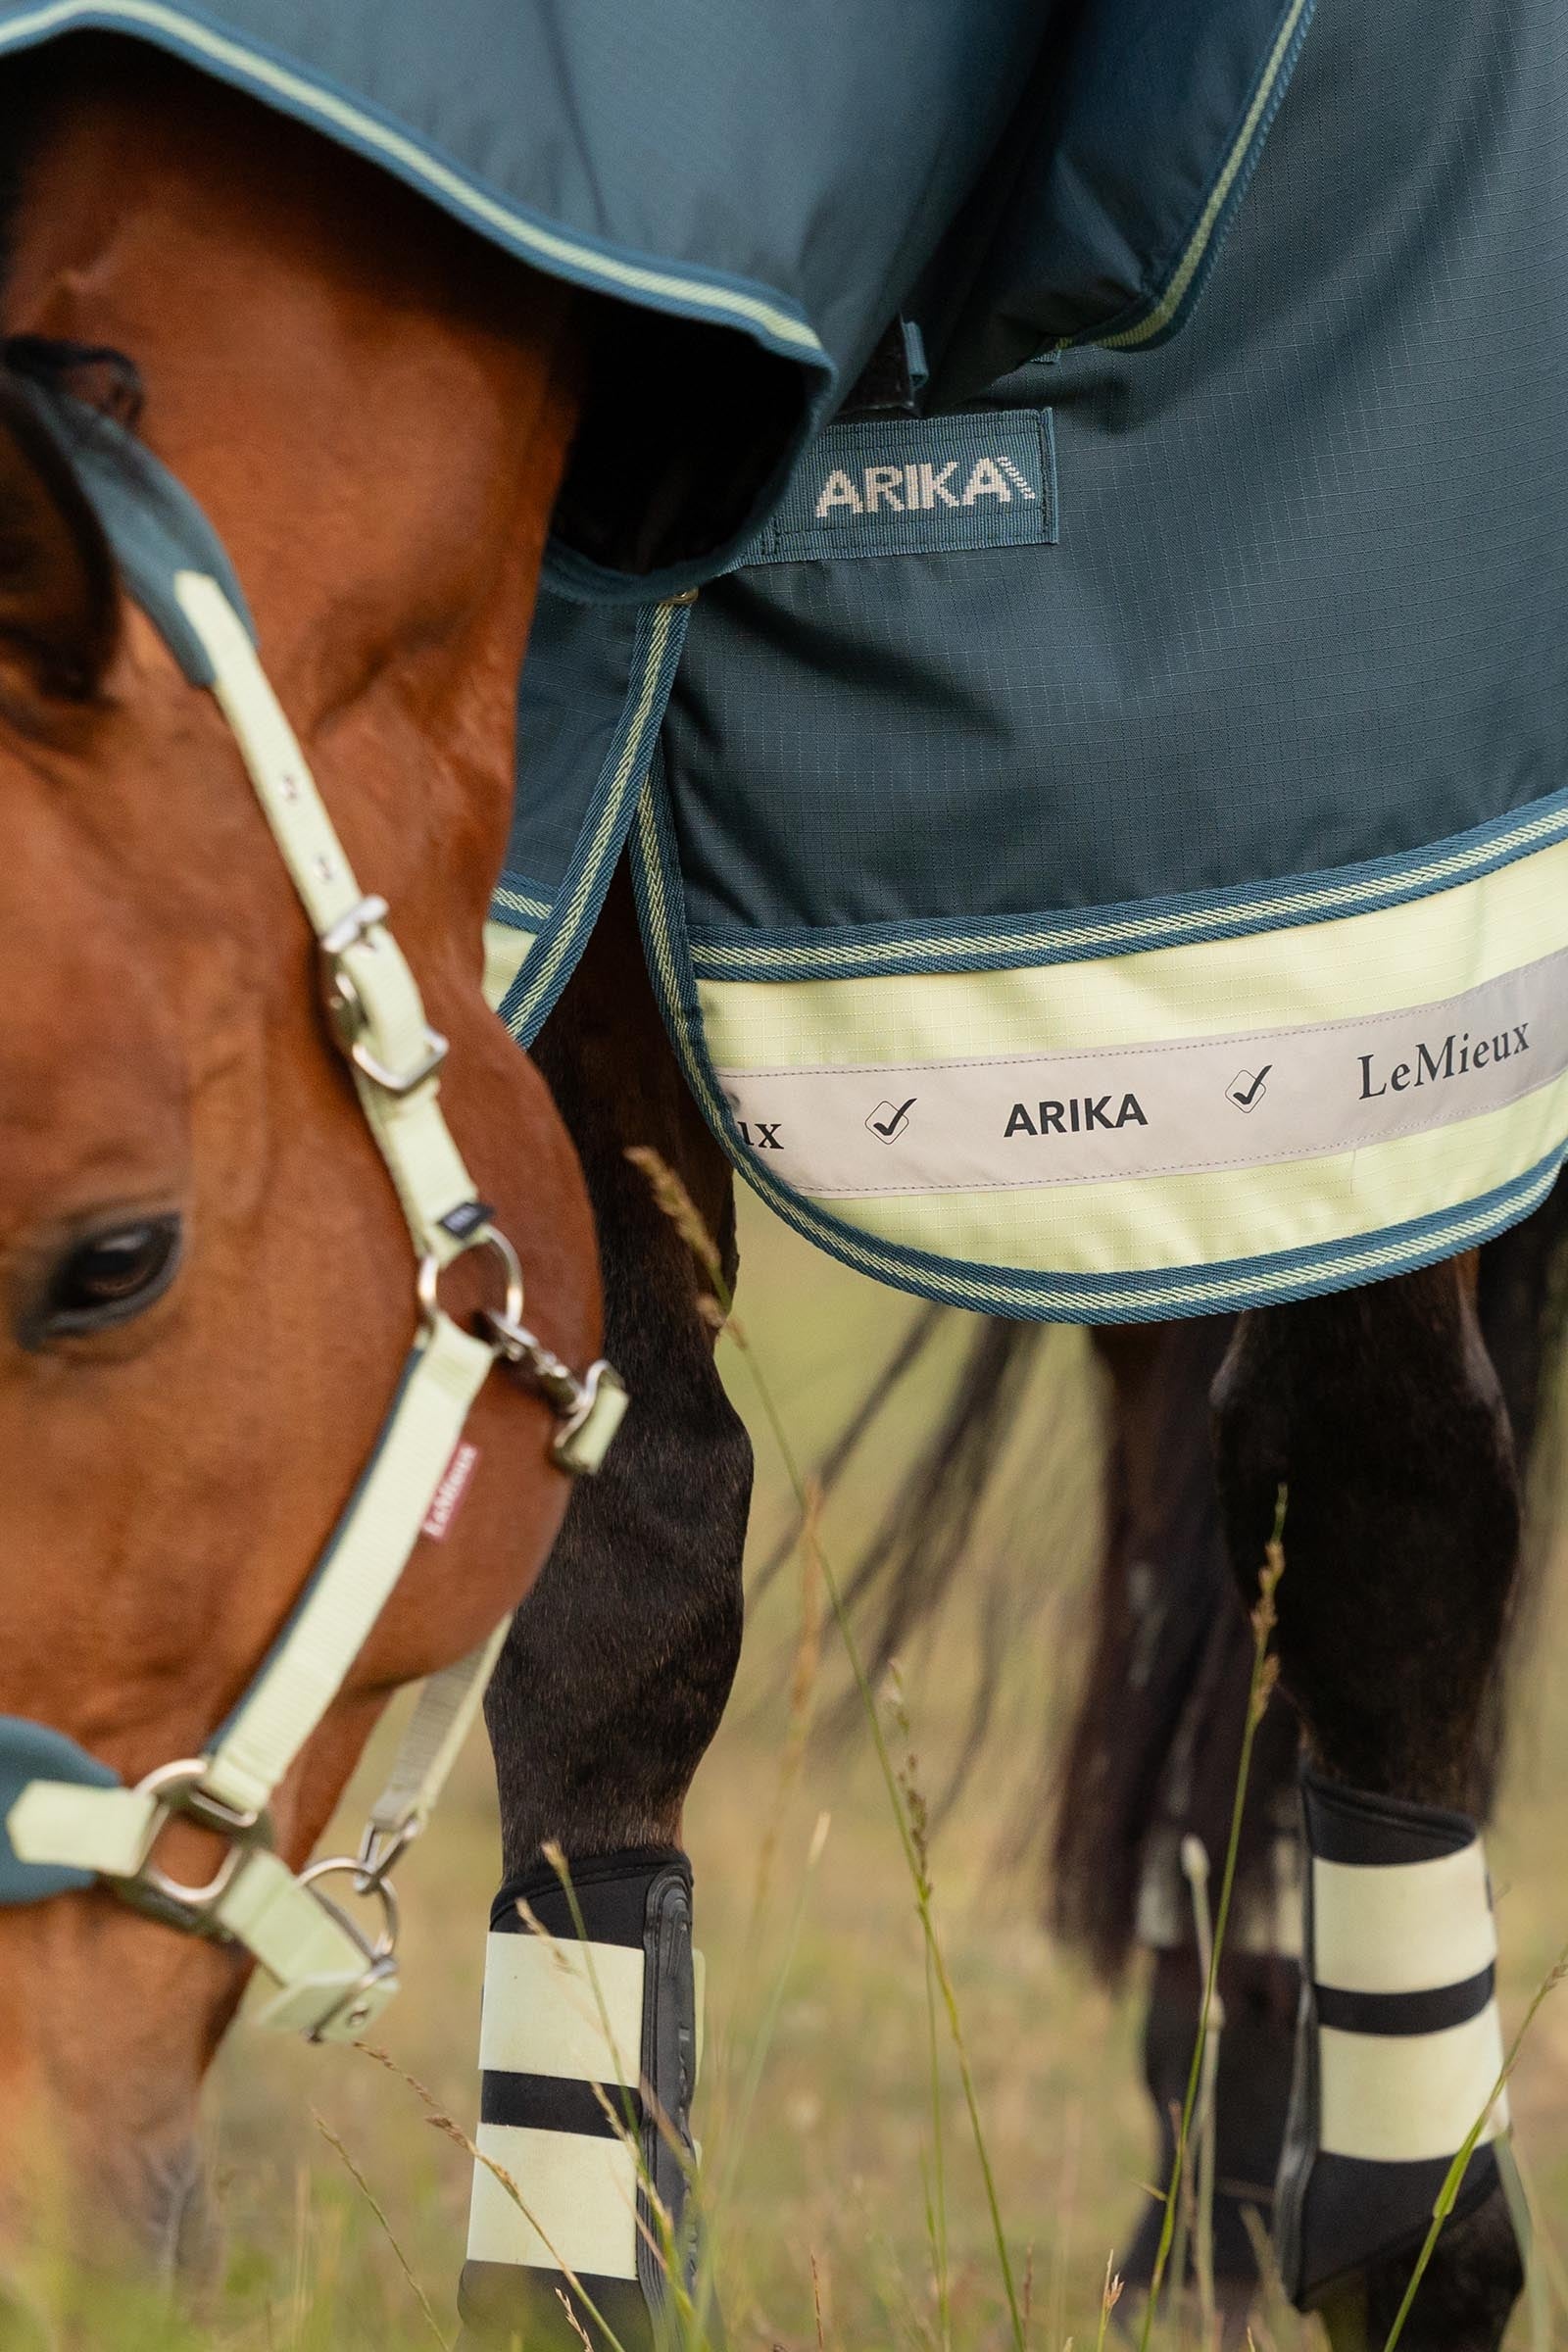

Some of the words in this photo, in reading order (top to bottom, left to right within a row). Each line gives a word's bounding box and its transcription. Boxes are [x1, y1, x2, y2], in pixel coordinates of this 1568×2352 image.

[815, 457, 1011, 518] ARIKA
[1004, 1093, 1149, 1138] ARIKA
[1357, 1023, 1530, 1100] LeMieux
